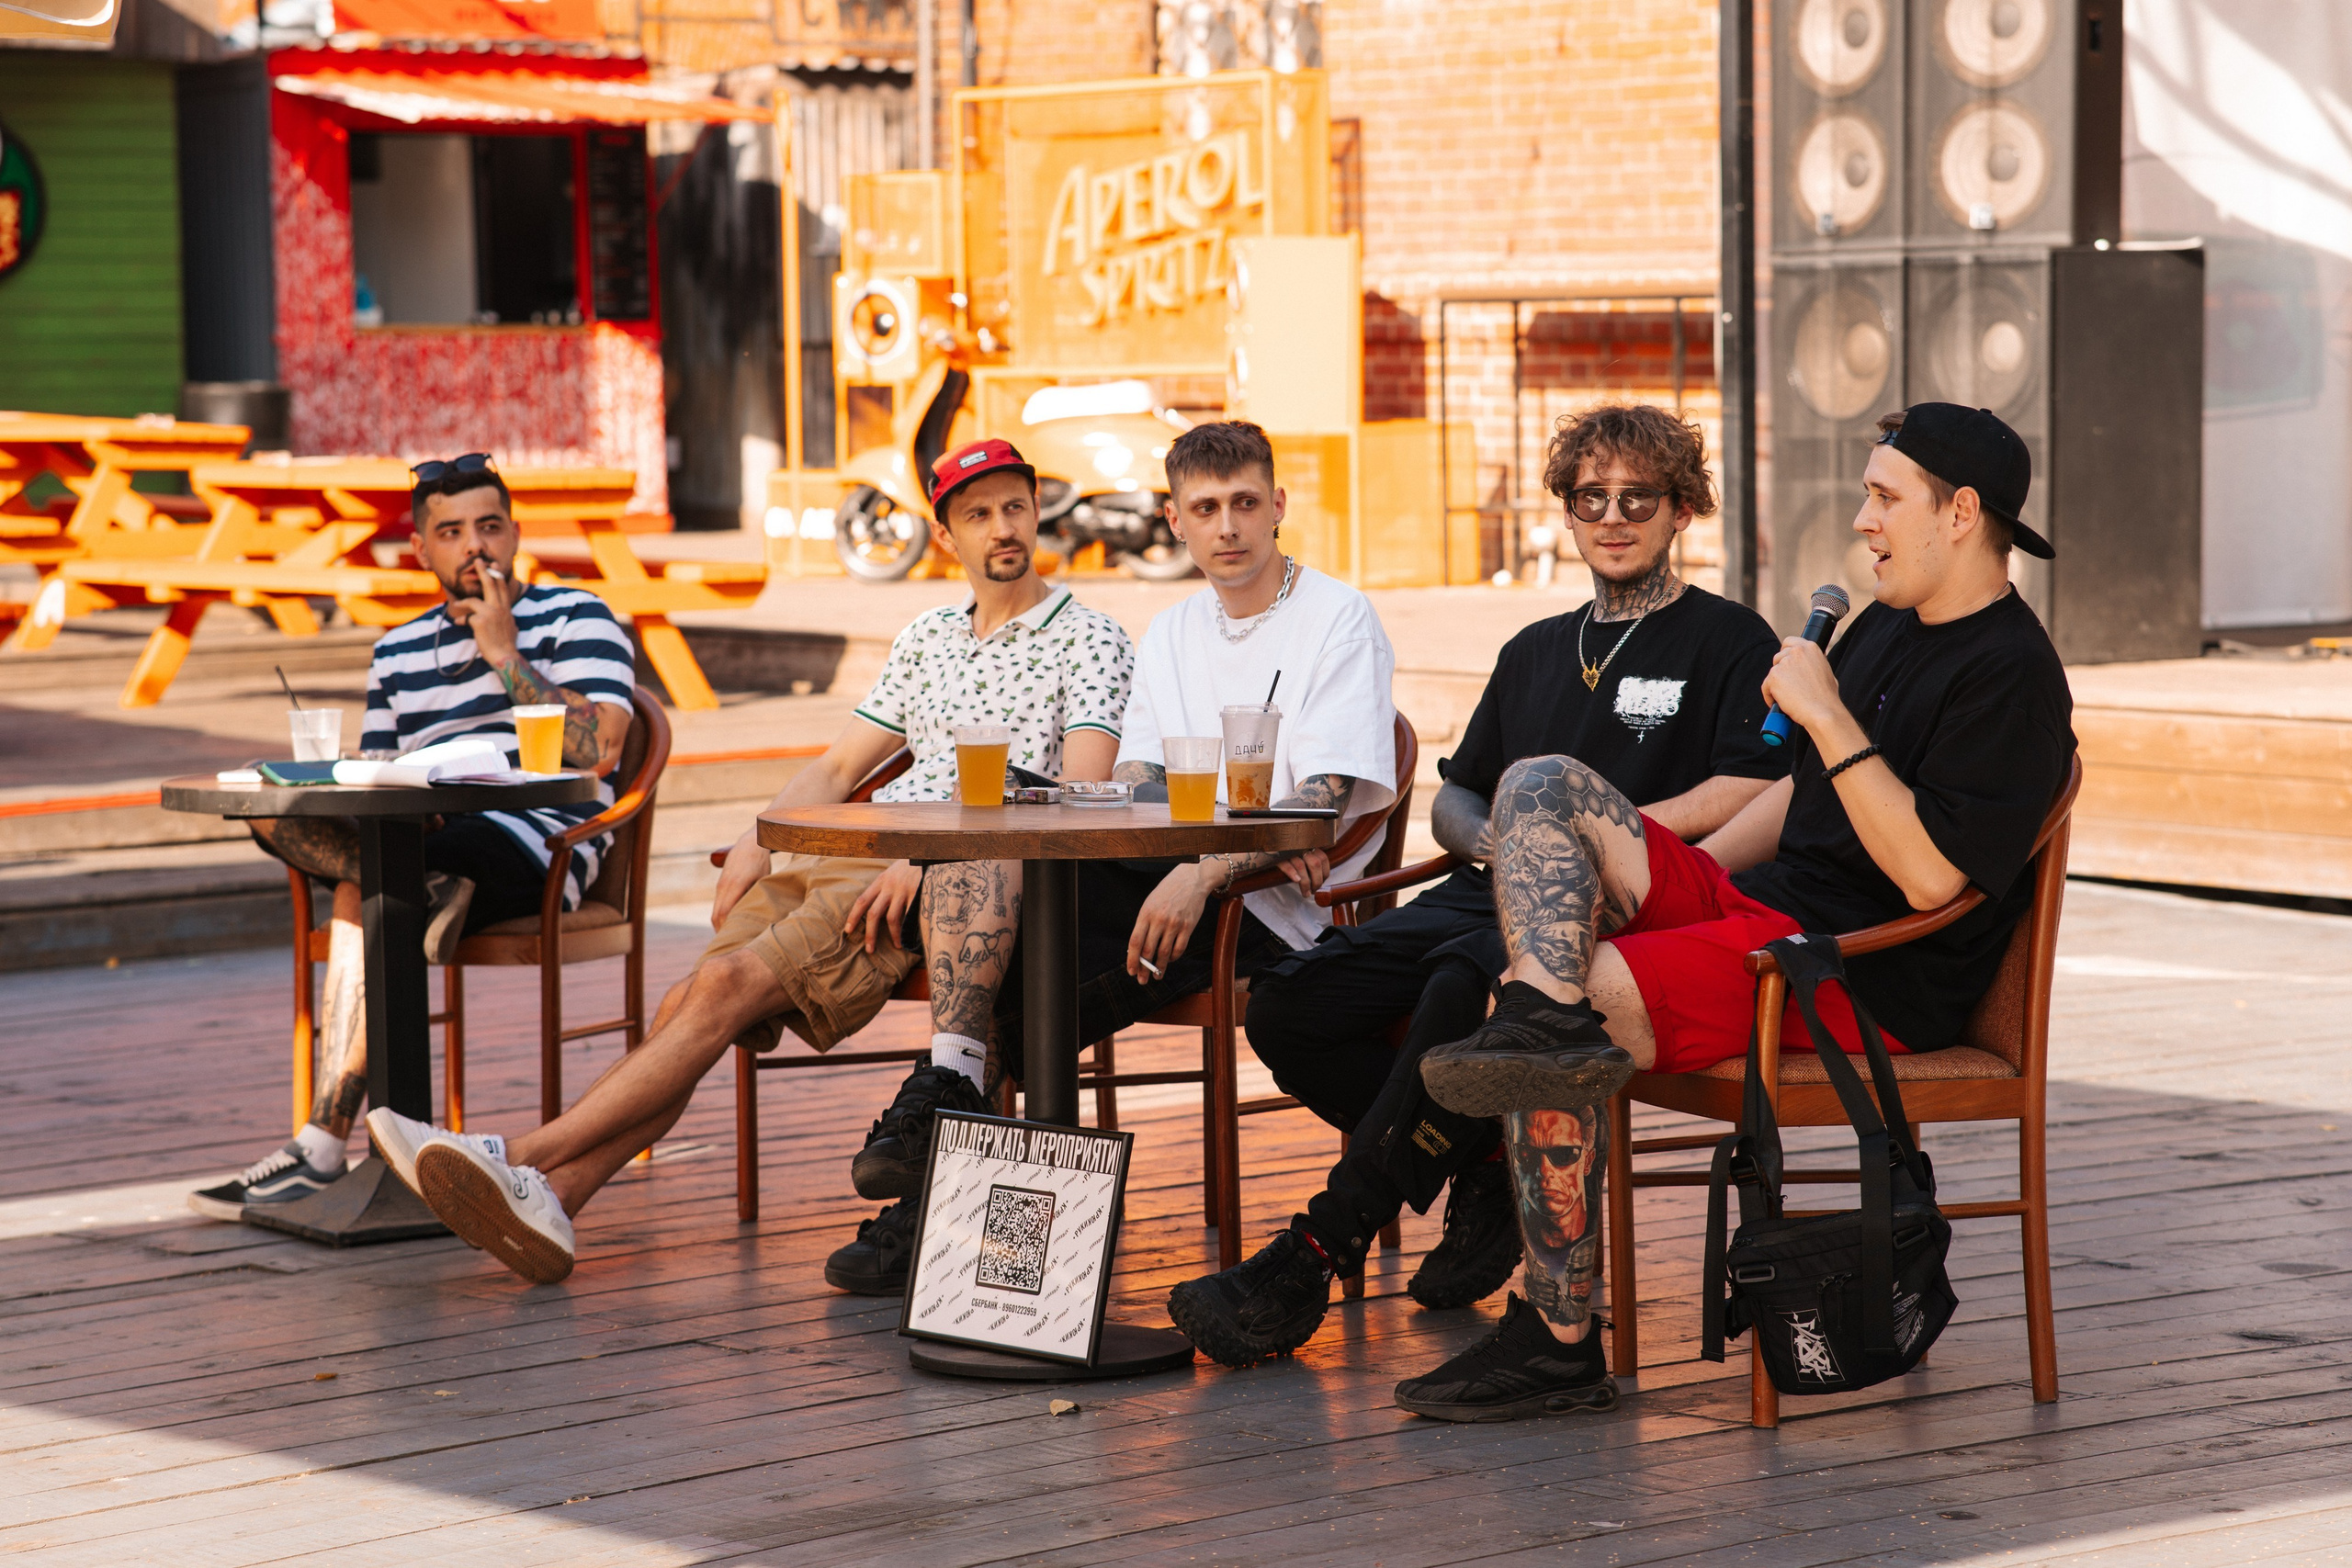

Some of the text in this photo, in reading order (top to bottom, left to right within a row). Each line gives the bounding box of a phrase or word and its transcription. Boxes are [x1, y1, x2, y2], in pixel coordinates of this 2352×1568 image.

[1042, 130, 1264, 276] APEROL
[1054, 228, 1227, 325] SPRITZ
[937, 1118, 1024, 1162] ПОДДЕРЖАТЬ
[1420, 1120, 1452, 1149] LOADING
[971, 1298, 998, 1310] СБЕРБАНК
[1002, 1303, 1037, 1316] 89601223959
